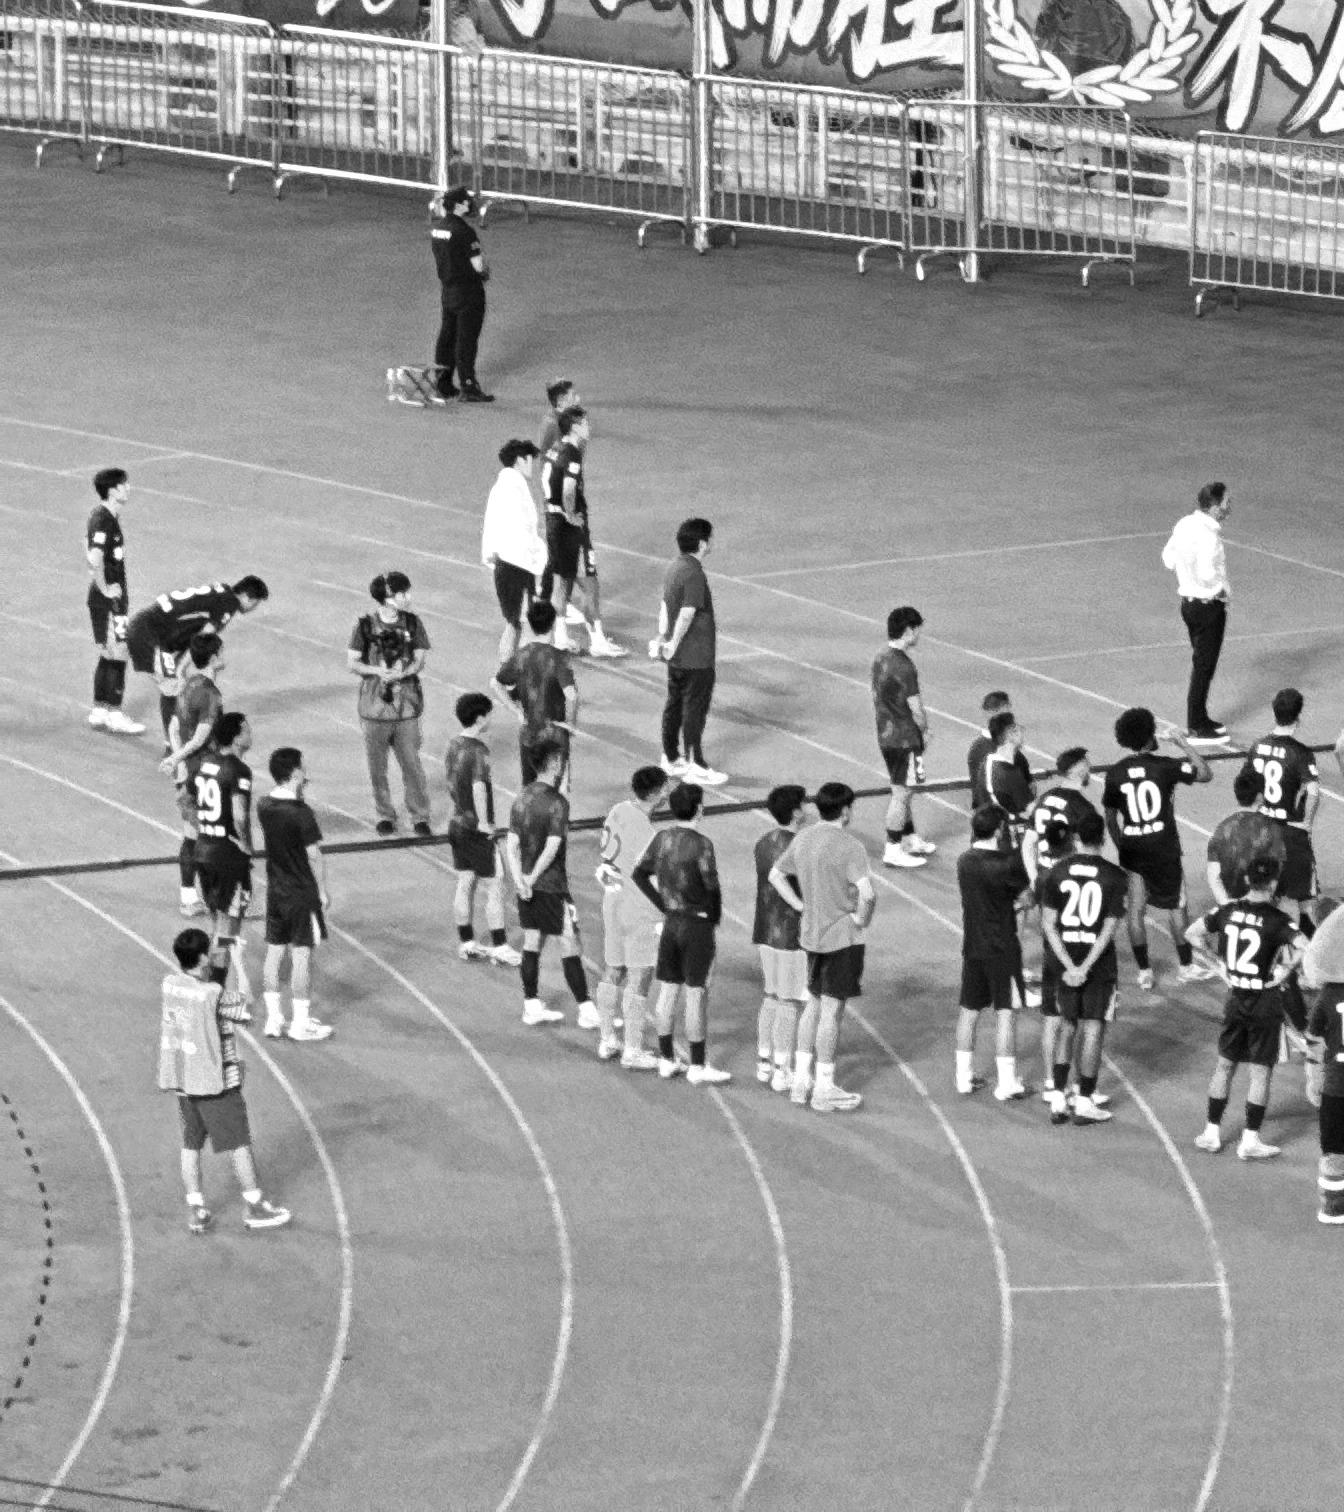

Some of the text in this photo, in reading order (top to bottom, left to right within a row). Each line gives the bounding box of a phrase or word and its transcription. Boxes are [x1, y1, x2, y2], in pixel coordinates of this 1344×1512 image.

[1120, 780, 1162, 823] 10
[1060, 879, 1103, 927] 20
[1224, 924, 1261, 975] 12
